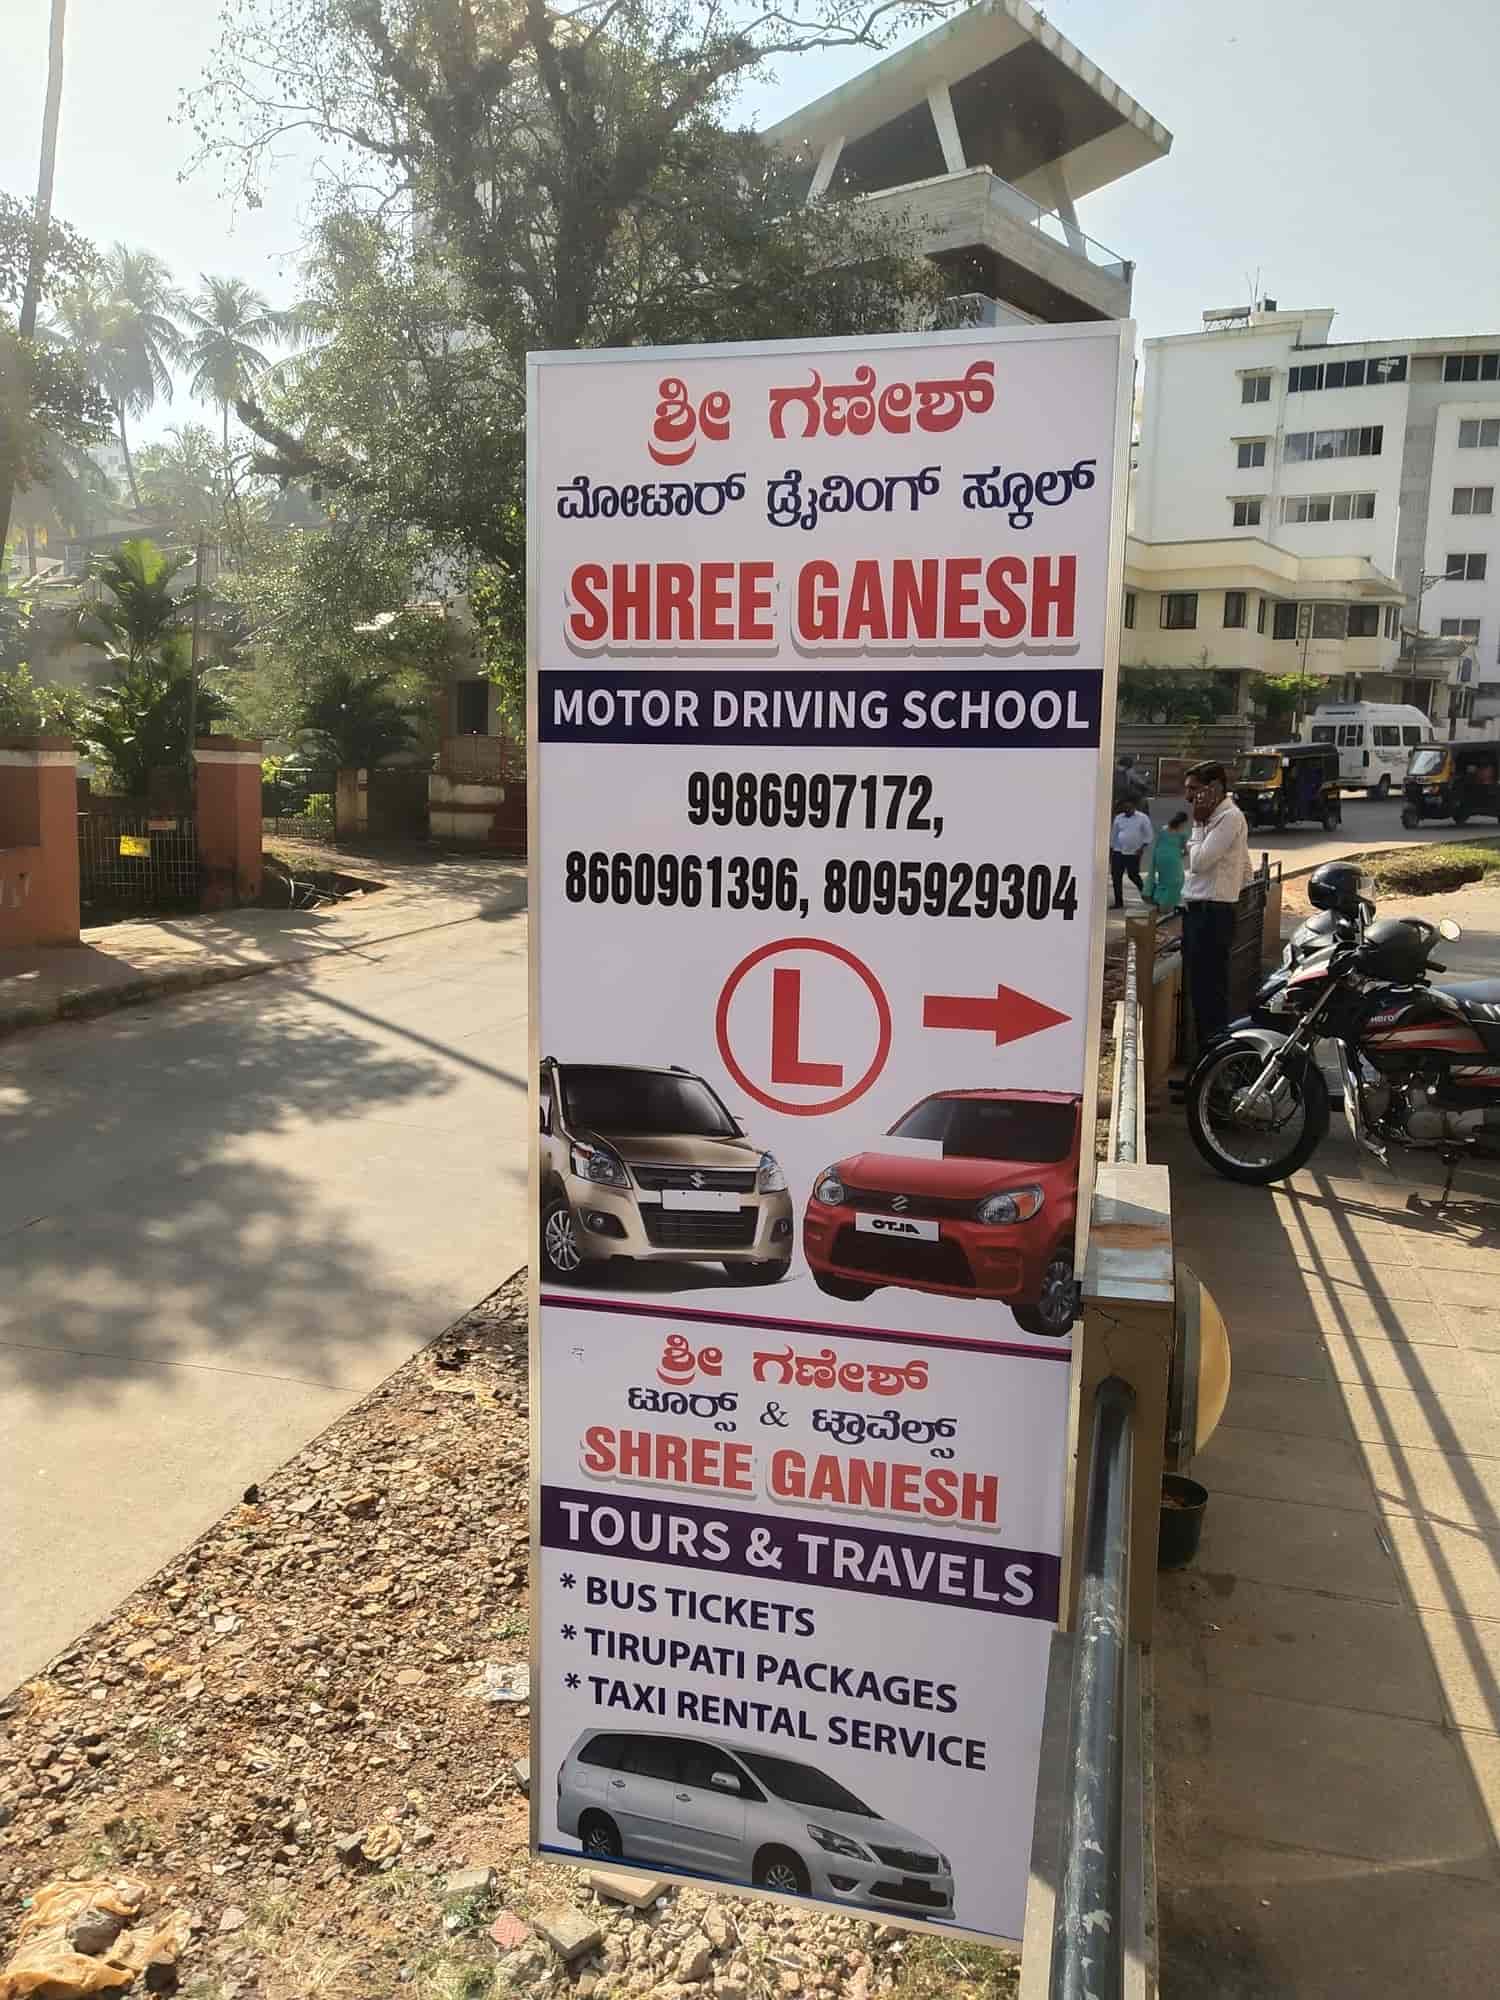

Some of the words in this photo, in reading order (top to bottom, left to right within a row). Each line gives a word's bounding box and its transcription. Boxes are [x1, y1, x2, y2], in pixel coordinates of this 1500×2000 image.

[648, 378, 730, 466] ಶ್ರೀ
[769, 360, 994, 438] ಗಣೇಶ್
[557, 472, 746, 518] ಮೋಟಾರ್
[768, 466, 941, 530] ಡ್ರೈವಿಂಗ್
[963, 460, 1096, 529] ಸ್ಕೂಲ್
[570, 562, 774, 640] SHREE
[799, 555, 1075, 640] GANESH
[555, 690, 698, 726] MOTOR
[714, 691, 887, 728] DRIVING
[903, 691, 1088, 729] SCHOOL
[688, 772, 943, 838] 9986997172,
[566, 851, 808, 919] 8660961396,
[824, 860, 1077, 920] 8095929304
[770, 968, 843, 1088] L
[657, 1334, 722, 1384] ಶ್ರೀ
[753, 1349, 927, 1395] ಗಣೇಶ್
[629, 1388, 738, 1432] ಟೂರ್ಸ್
[760, 1402, 788, 1427] &
[813, 1409, 957, 1459] ಟ್ರಾವೆಲ್ಸ್
[585, 1427, 752, 1489] SHREE
[773, 1450, 996, 1522] GANESH
[560, 1502, 730, 1561] TOURS
[746, 1528, 782, 1569] &
[799, 1534, 1034, 1607] TRAVELS
[587, 1576, 656, 1612] BUS
[665, 1588, 814, 1636] TICKETS
[584, 1627, 744, 1679] TIRUPATI
[757, 1655, 957, 1713] PACKAGES
[588, 1676, 665, 1715] TAXI
[678, 1691, 817, 1740] RENTAL
[829, 1717, 986, 1771] SERVICE
